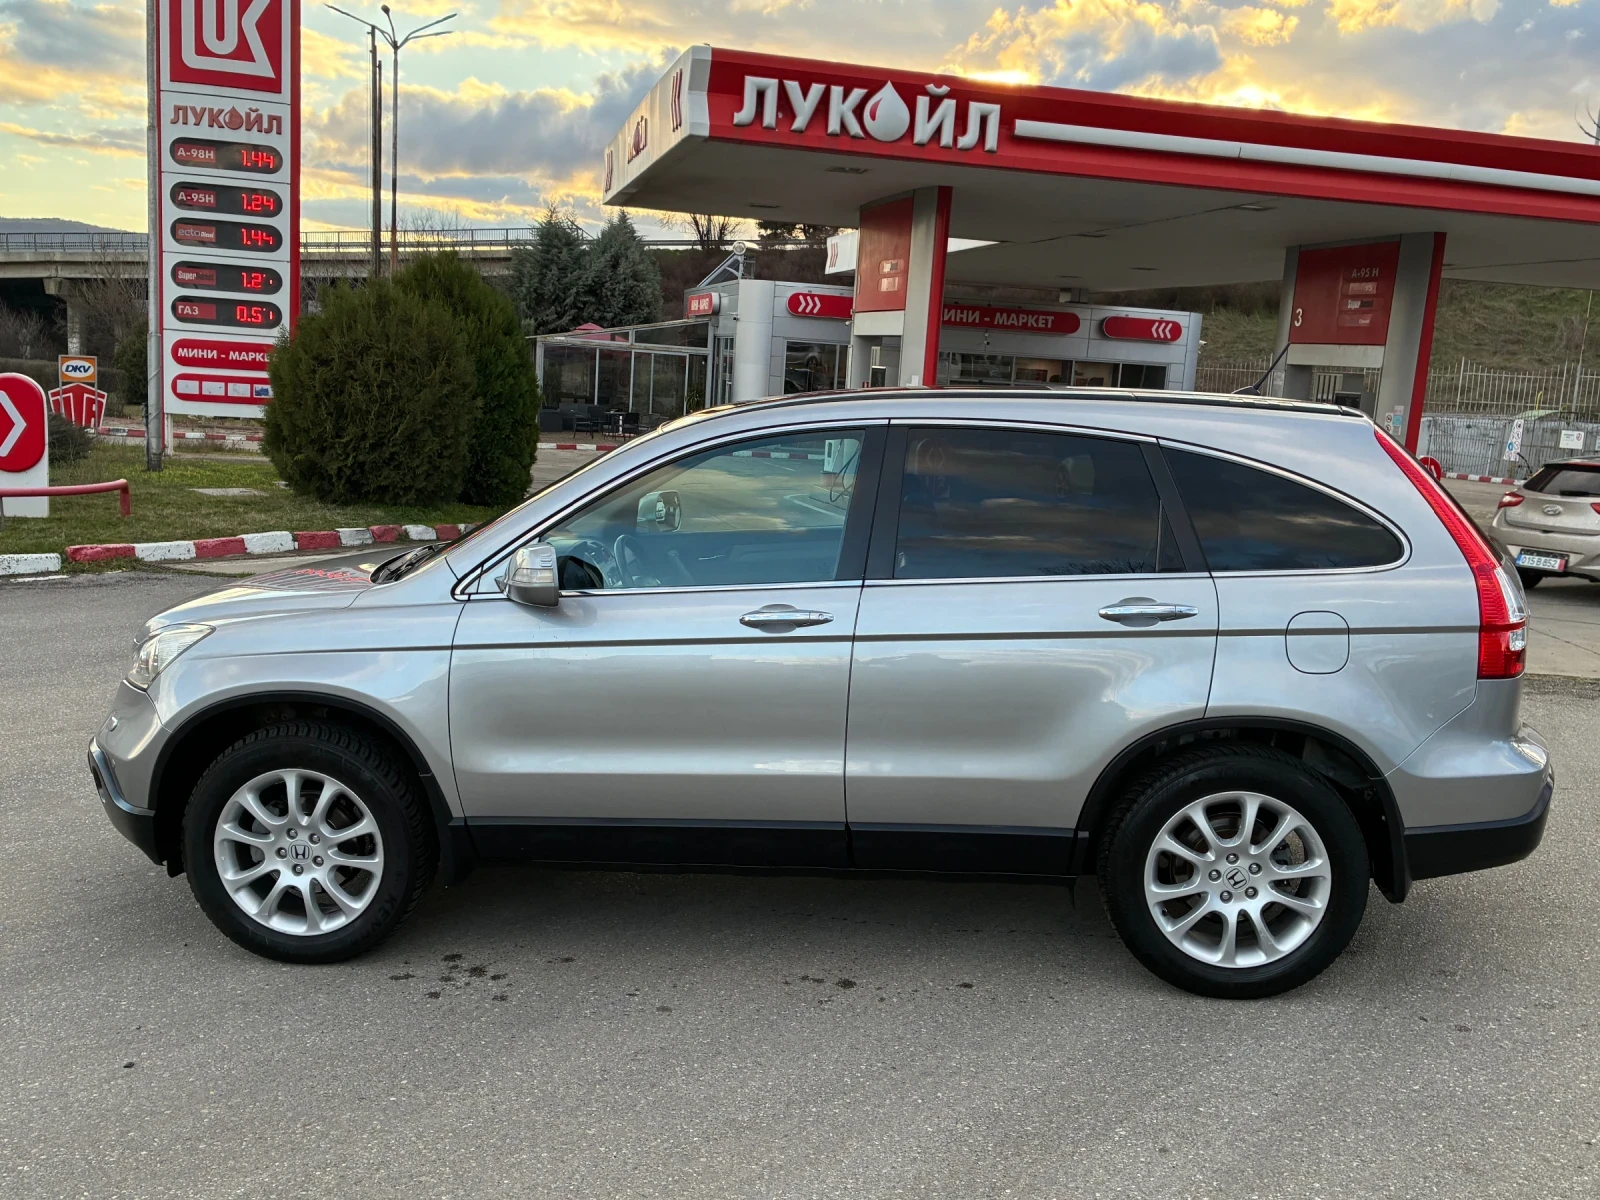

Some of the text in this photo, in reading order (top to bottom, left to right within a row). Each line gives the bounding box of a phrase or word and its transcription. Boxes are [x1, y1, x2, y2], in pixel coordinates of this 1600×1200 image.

[170, 104, 282, 135] ЛУКОЙЛ
[733, 75, 1001, 153] ЛУКОЙЛ
[241, 149, 274, 169] 1.44
[241, 193, 274, 211] 1.24
[177, 305, 199, 315] ГАЗ
[943, 308, 980, 323] ИНИ
[994, 312, 1055, 329] МАРКЕТ
[1294, 308, 1303, 327] 3
[177, 347, 218, 359] МИНИ
[64, 364, 92, 374] DKV
